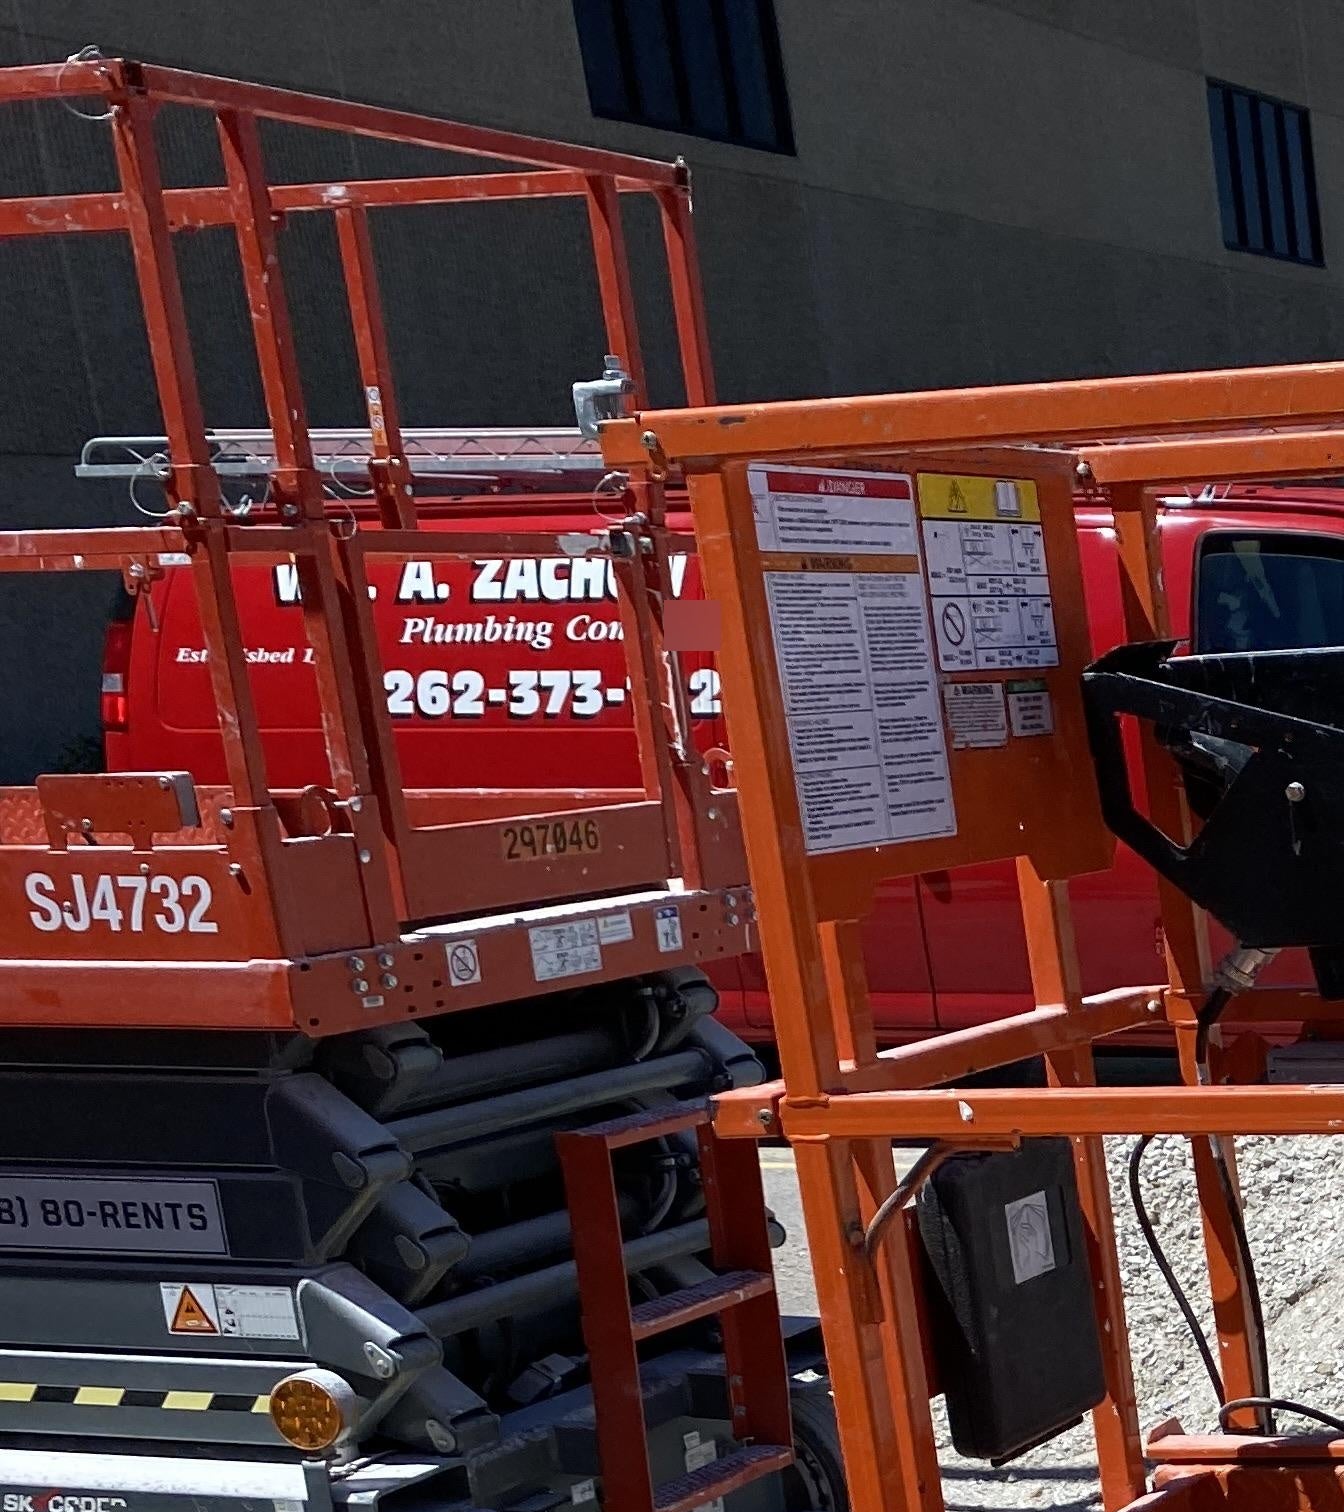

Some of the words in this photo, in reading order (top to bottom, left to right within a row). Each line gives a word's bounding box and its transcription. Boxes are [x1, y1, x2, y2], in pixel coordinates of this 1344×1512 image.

[399, 560, 450, 600] A.
[473, 555, 687, 600] ZACH
[399, 615, 553, 649] Plumbing
[504, 820, 599, 859] 297046
[25, 872, 218, 933] SJ4732
[40, 1199, 209, 1231] 80-RENTS
